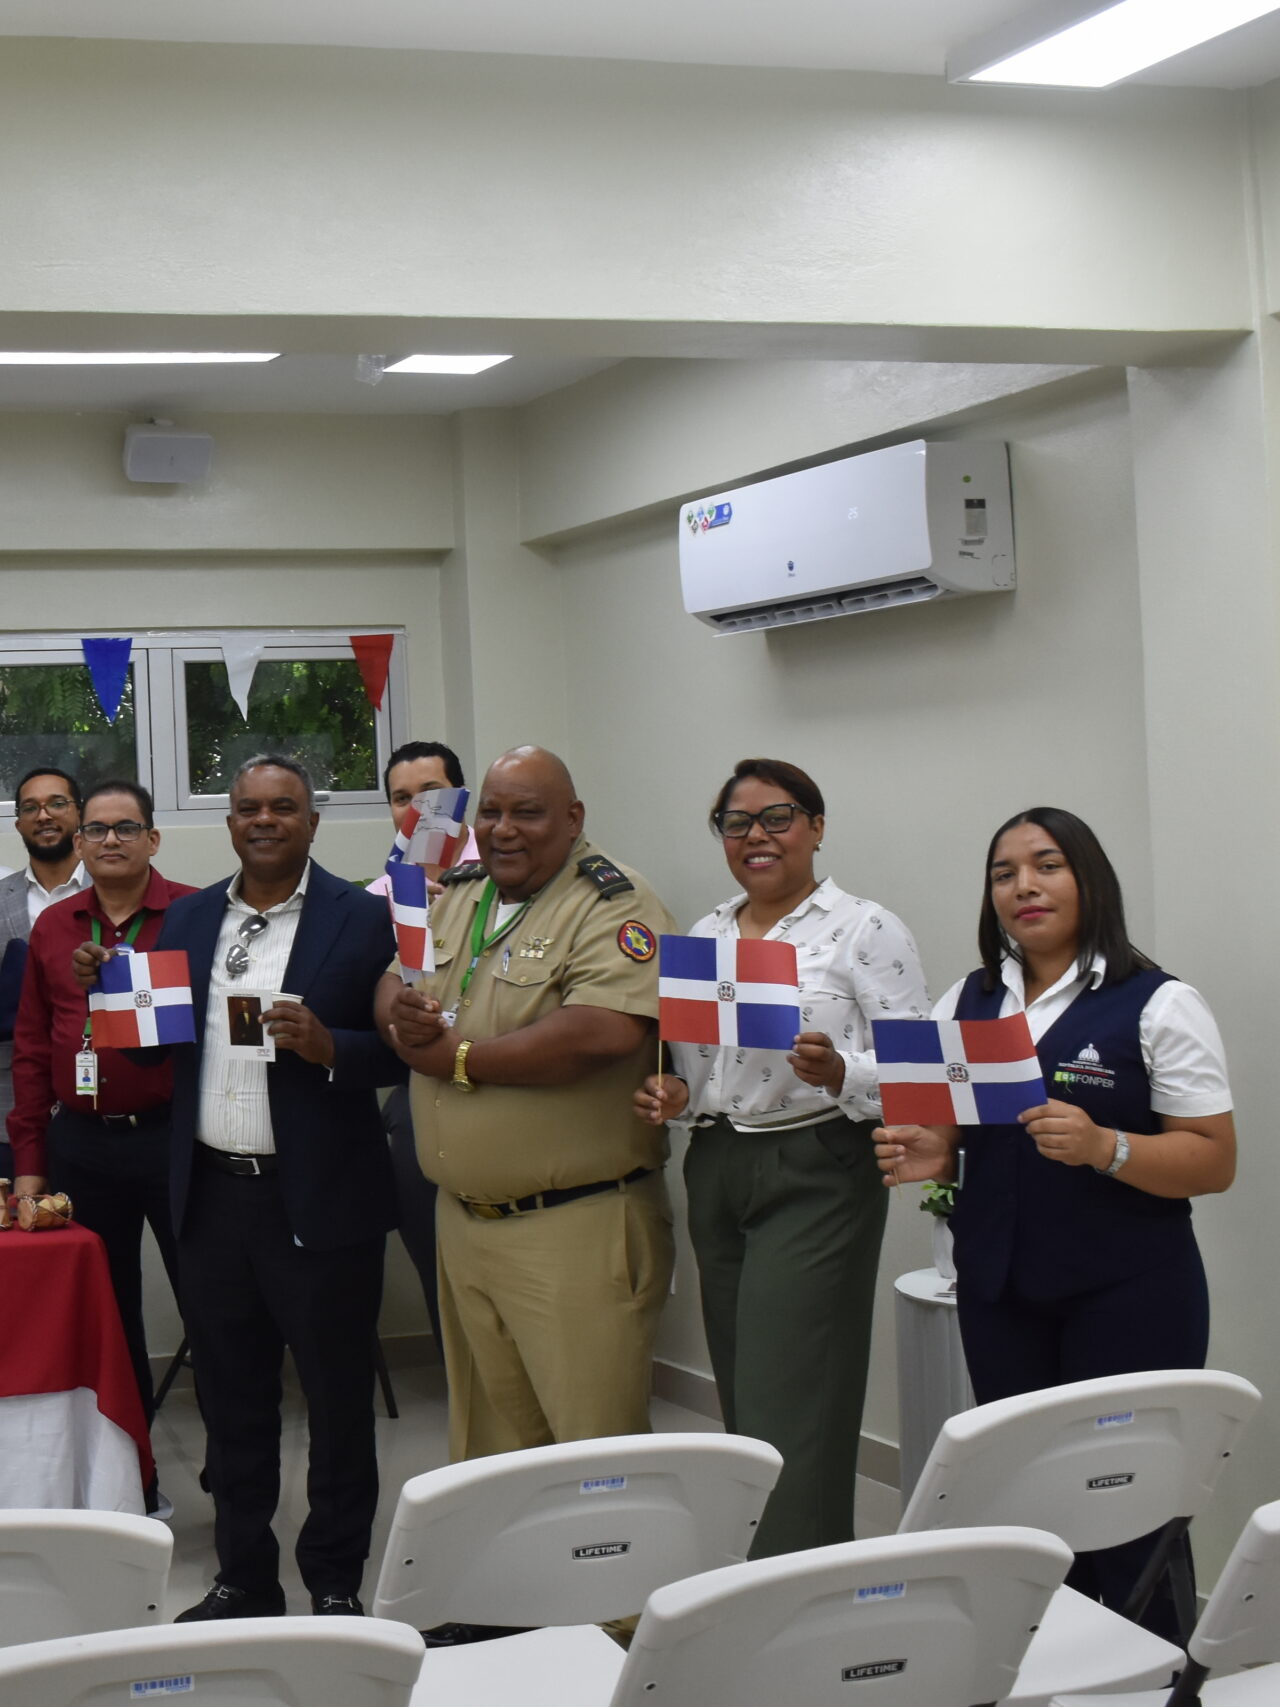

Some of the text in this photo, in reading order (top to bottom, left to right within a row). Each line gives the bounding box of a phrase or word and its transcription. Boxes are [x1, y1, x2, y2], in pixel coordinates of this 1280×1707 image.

[1076, 1074, 1115, 1089] FONPER
[579, 1544, 623, 1557] LIFETIME
[849, 1663, 899, 1677] LIFETIME
